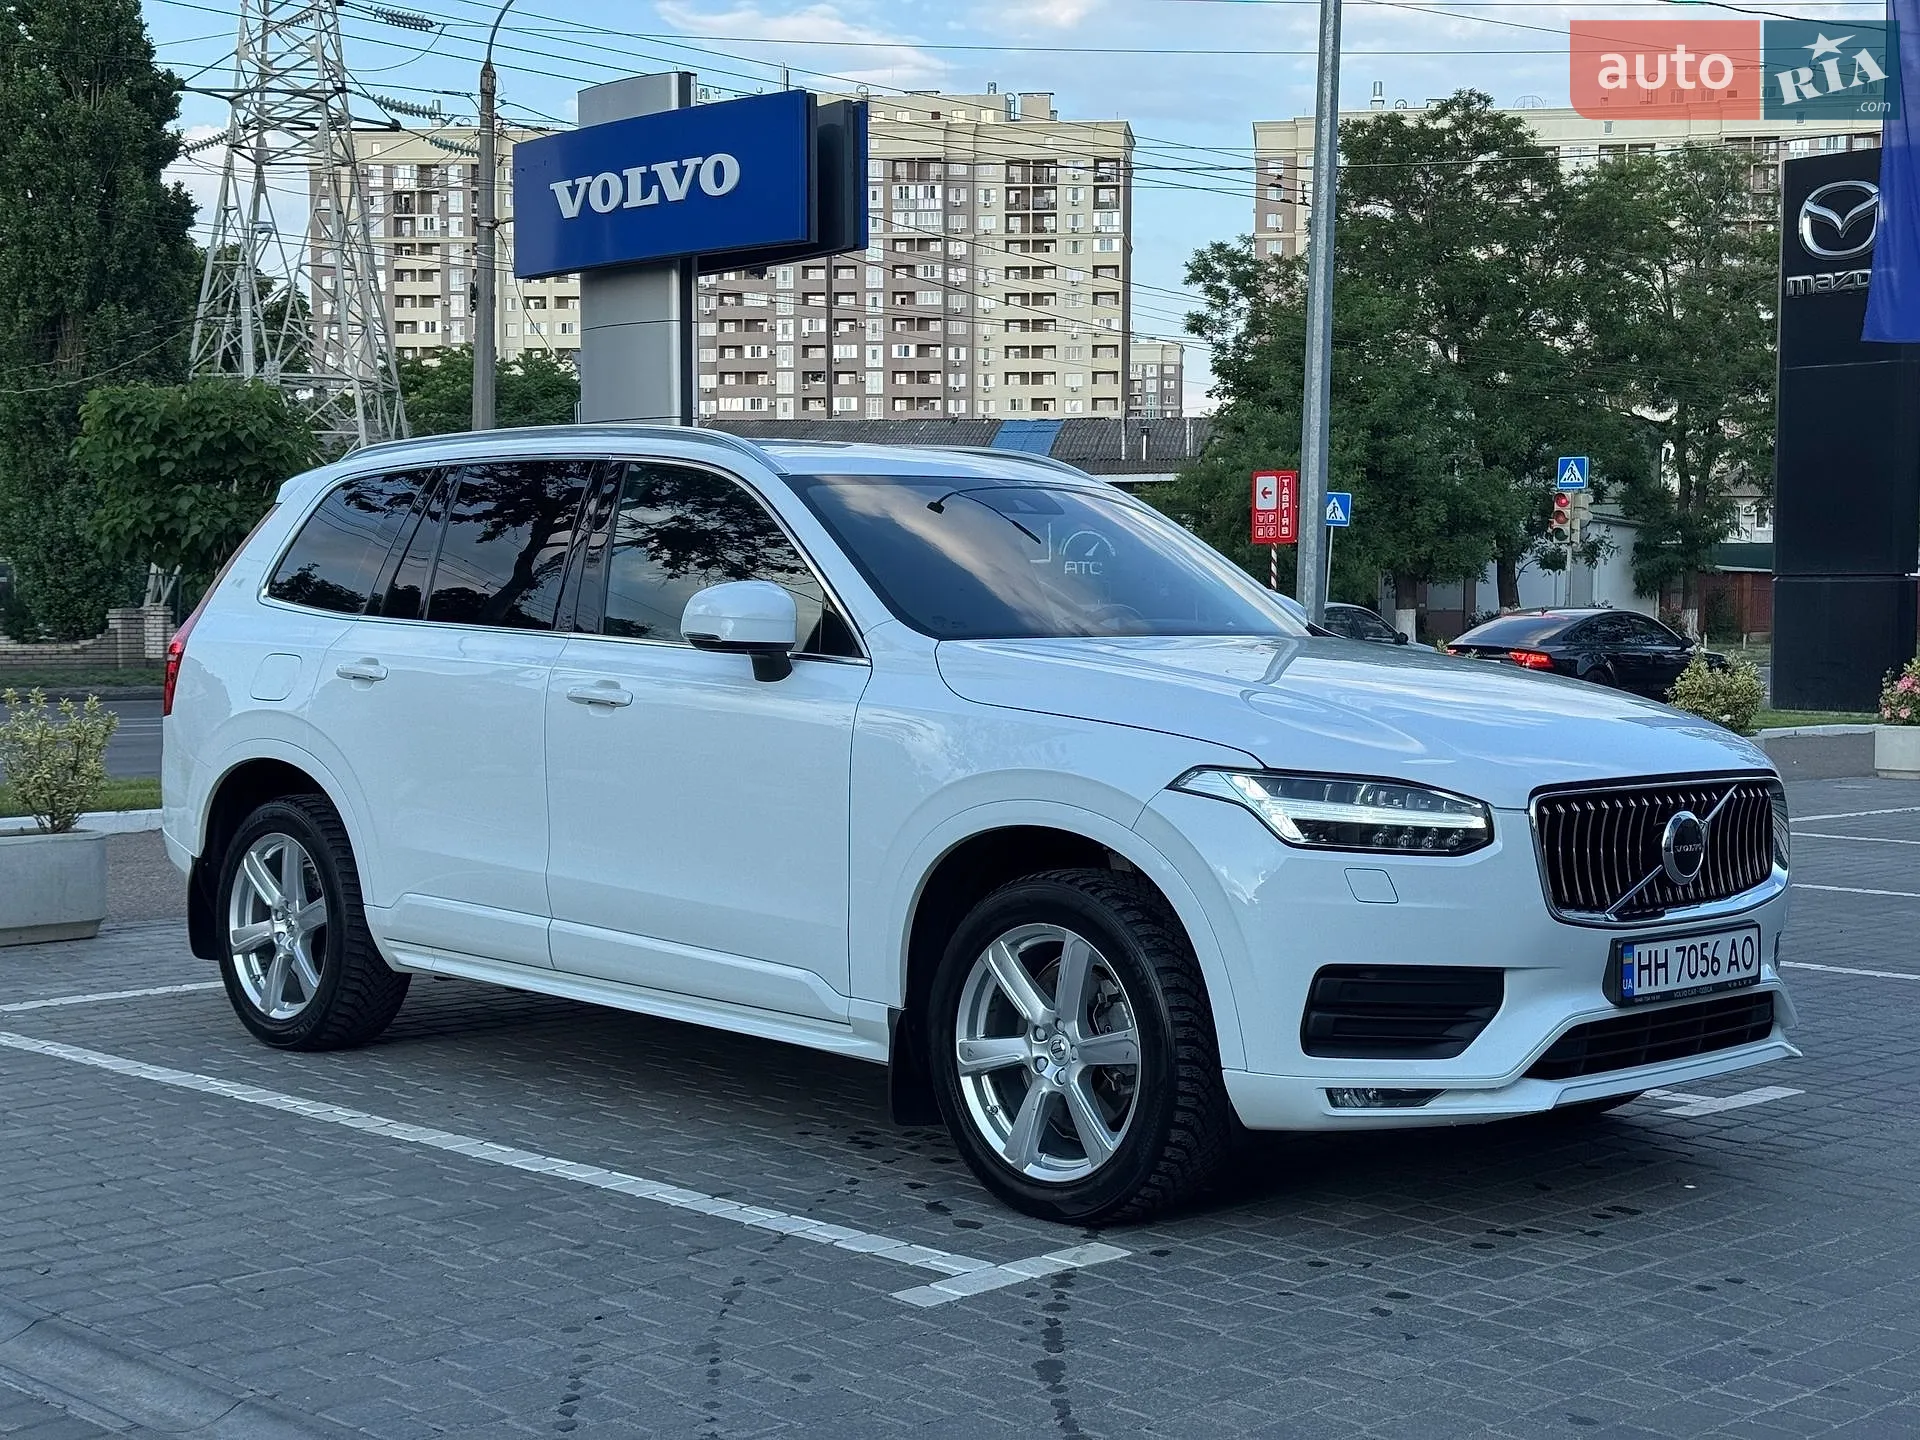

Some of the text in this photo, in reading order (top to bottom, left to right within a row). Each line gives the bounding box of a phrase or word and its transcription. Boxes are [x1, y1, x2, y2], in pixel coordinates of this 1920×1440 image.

[550, 153, 741, 219] VOLVO
[1622, 978, 1633, 990] UA
[1637, 935, 1755, 988] HH 7056 AO
